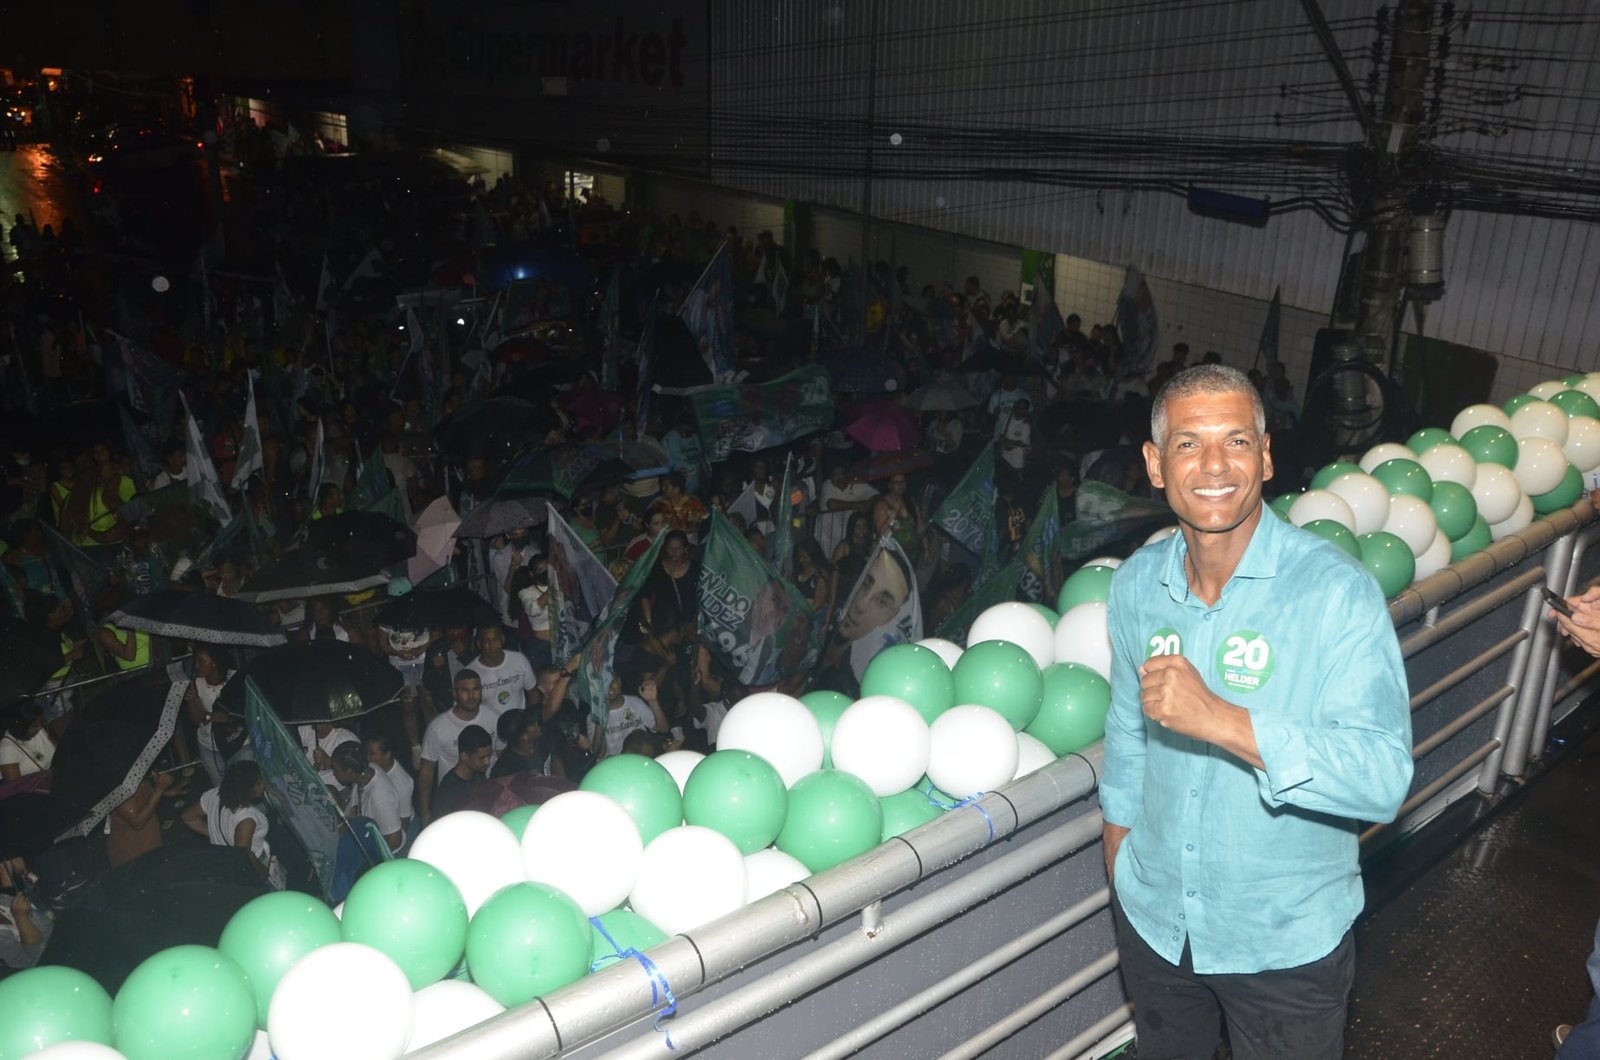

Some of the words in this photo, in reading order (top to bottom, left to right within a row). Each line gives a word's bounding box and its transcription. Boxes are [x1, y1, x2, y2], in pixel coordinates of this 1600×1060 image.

[451, 15, 687, 88] Supermarket
[1150, 634, 1180, 657] 20
[1222, 636, 1270, 670] 20
[1224, 671, 1260, 686] HELDER
